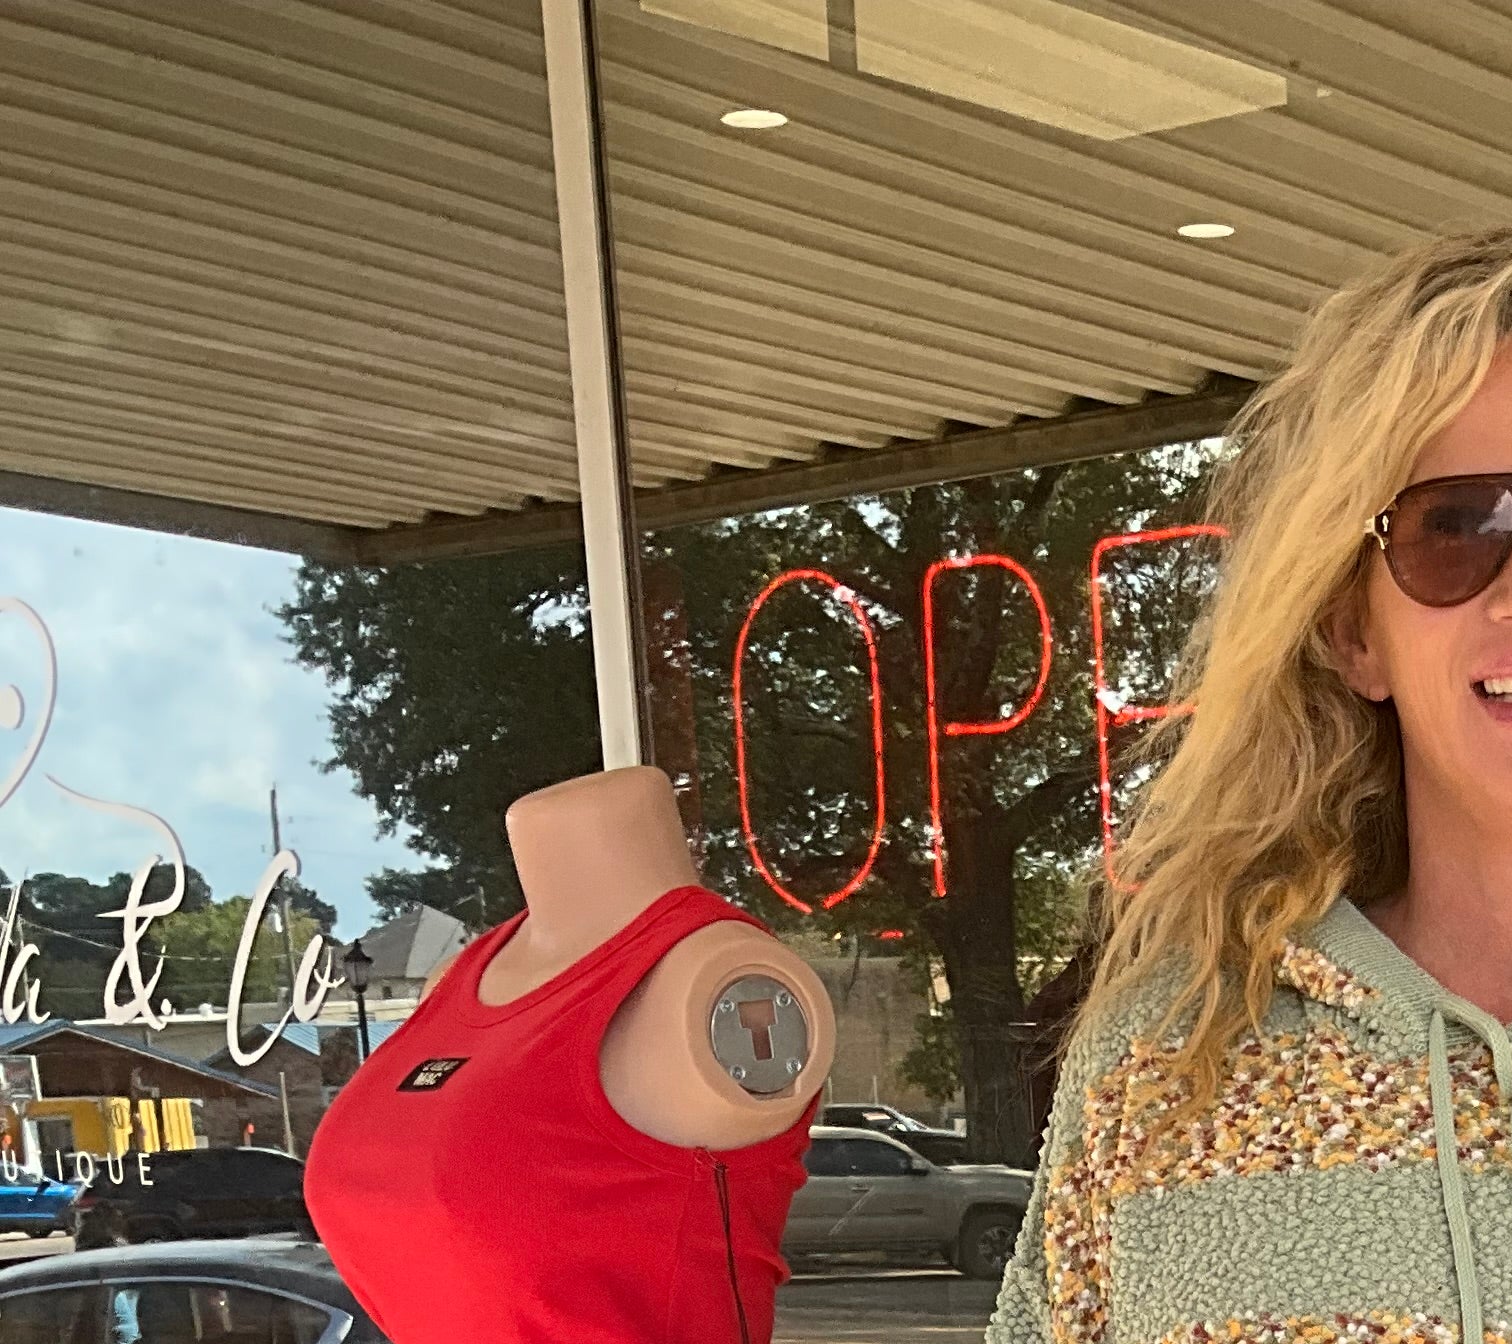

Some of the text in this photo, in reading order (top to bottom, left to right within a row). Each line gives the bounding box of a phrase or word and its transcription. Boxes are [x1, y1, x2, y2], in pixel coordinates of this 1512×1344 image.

[731, 524, 1231, 914] OPE
[95, 852, 187, 1032] &
[2, 1149, 154, 1188] UIQUE
